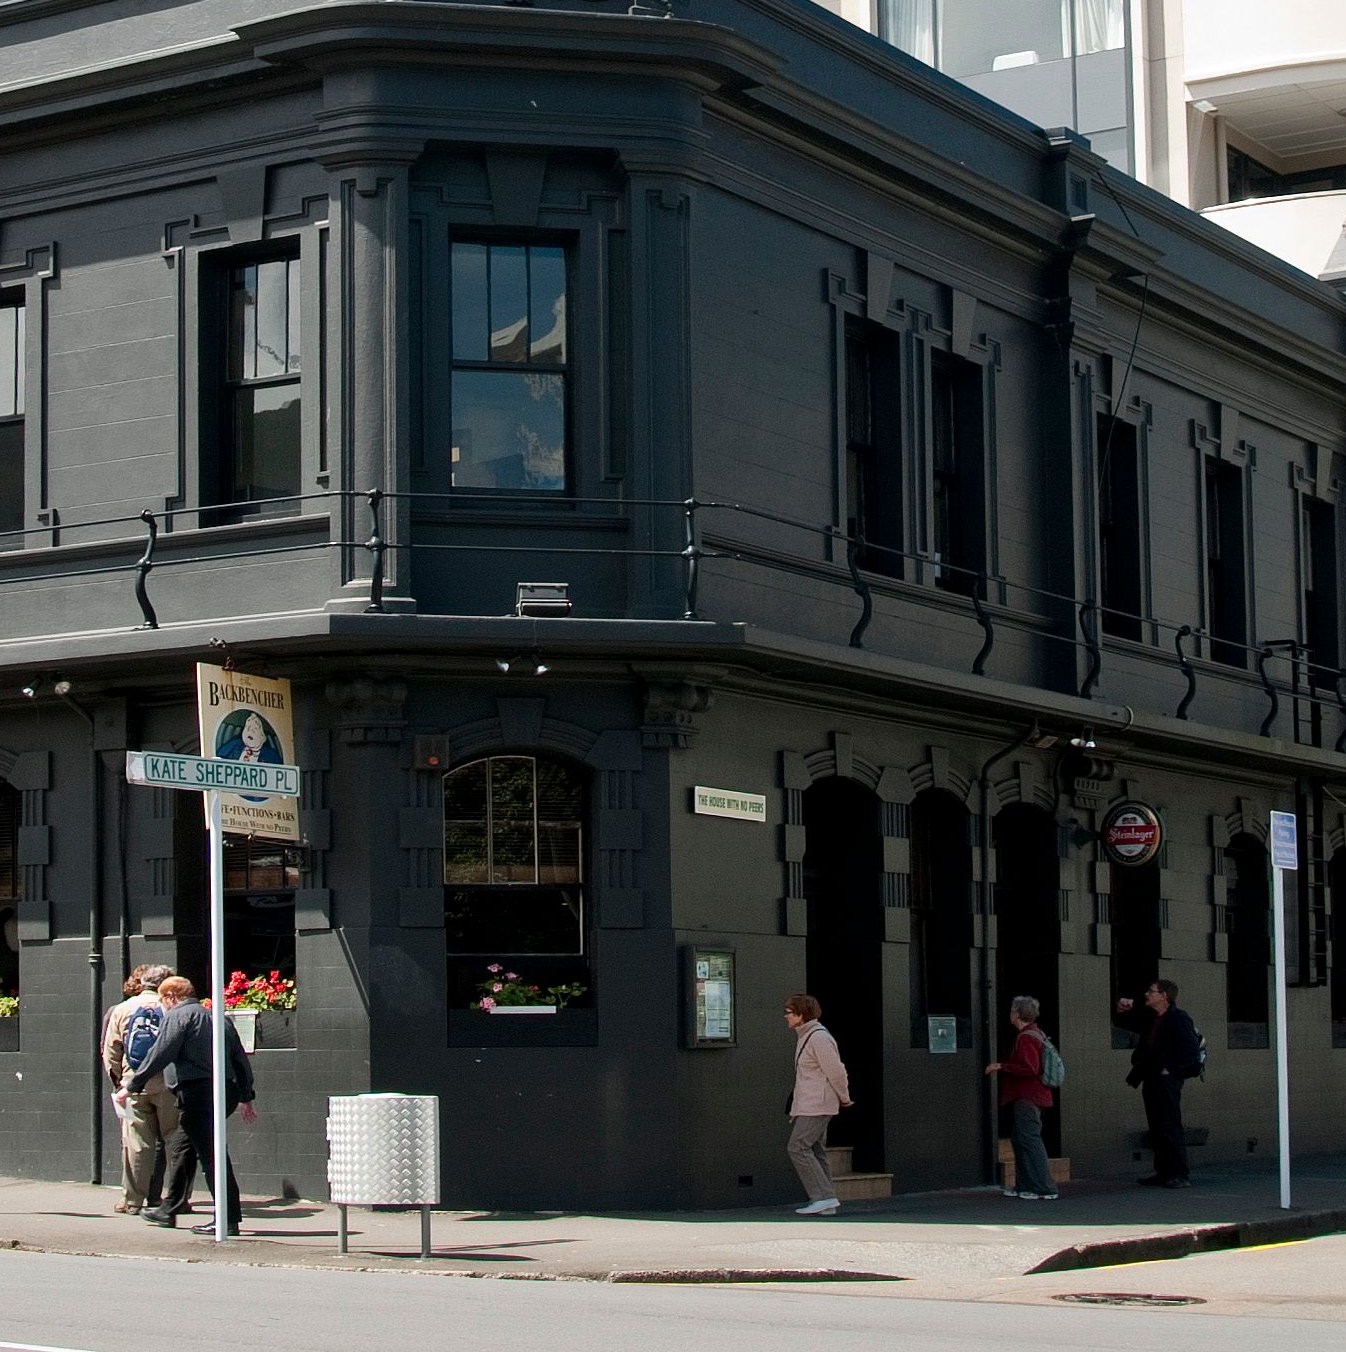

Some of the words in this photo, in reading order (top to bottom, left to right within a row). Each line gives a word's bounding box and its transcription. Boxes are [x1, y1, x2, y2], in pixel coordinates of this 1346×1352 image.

[151, 758, 187, 780] KATE
[196, 764, 268, 788] SHEPPARD
[275, 770, 292, 791] PL
[698, 794, 708, 806] THE
[709, 796, 726, 808] HOUSE
[1107, 827, 1154, 842] Steinlager
